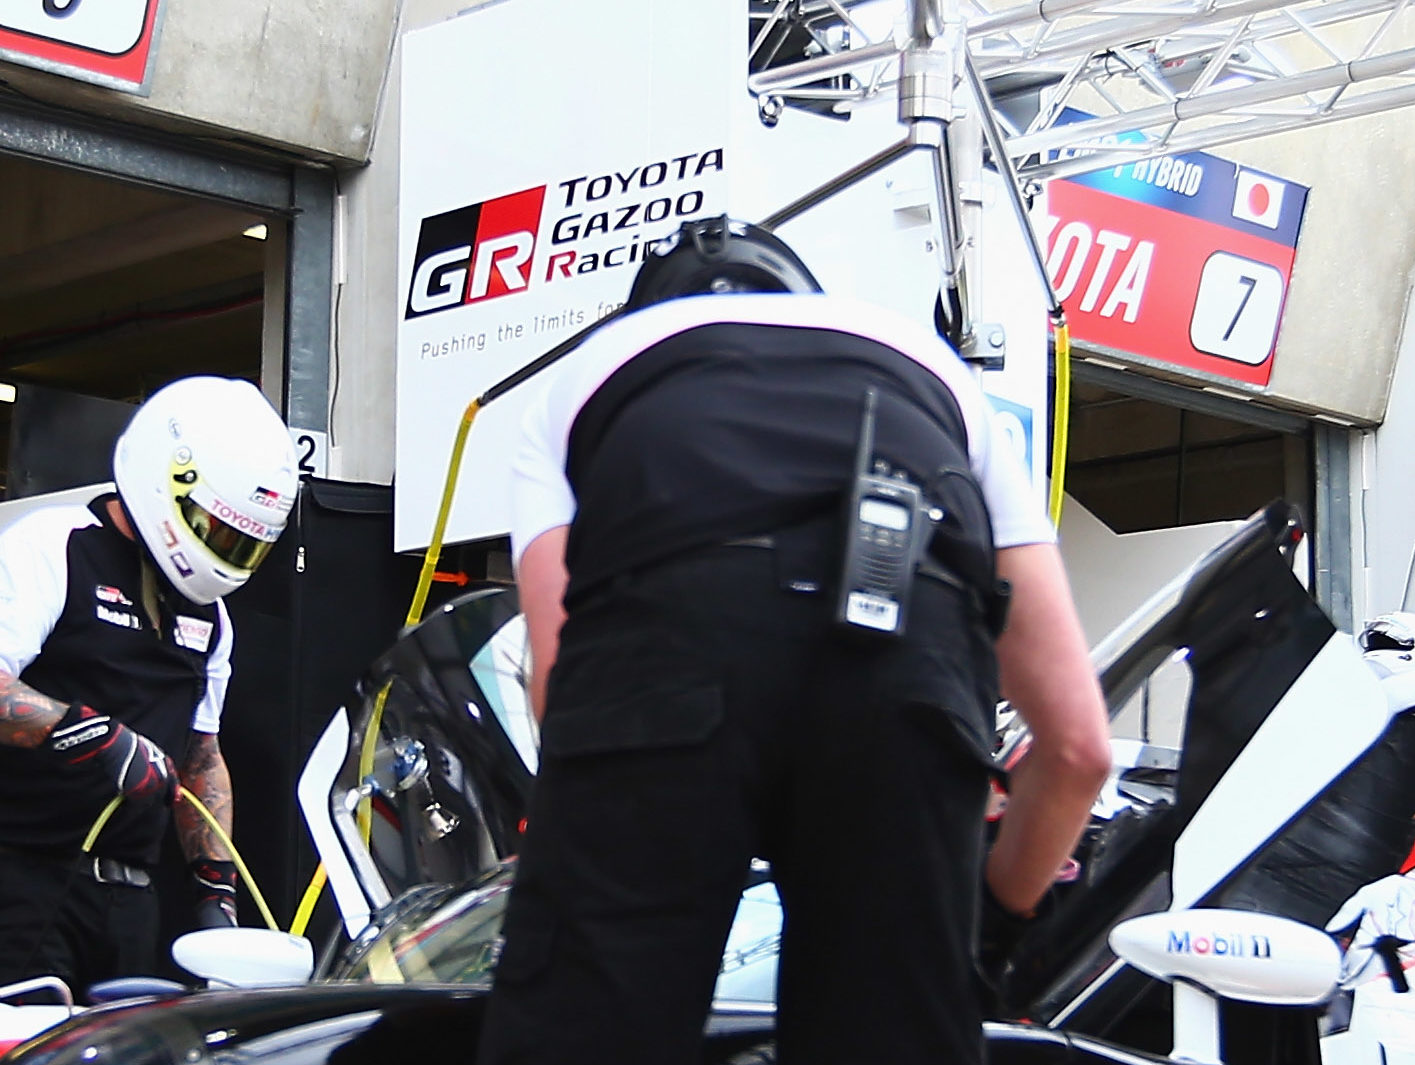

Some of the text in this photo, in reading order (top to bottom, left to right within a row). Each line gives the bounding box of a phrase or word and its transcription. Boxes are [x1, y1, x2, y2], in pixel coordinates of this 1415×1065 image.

[559, 147, 724, 208] TOYOTA
[551, 190, 705, 246] GAZOO
[410, 229, 535, 313] GR
[420, 332, 486, 360] Pushing
[497, 318, 523, 341] the
[533, 307, 584, 334] limits
[1221, 275, 1258, 342] 7
[210, 498, 266, 537] TOYOTA
[1166, 930, 1244, 958] Mobil
